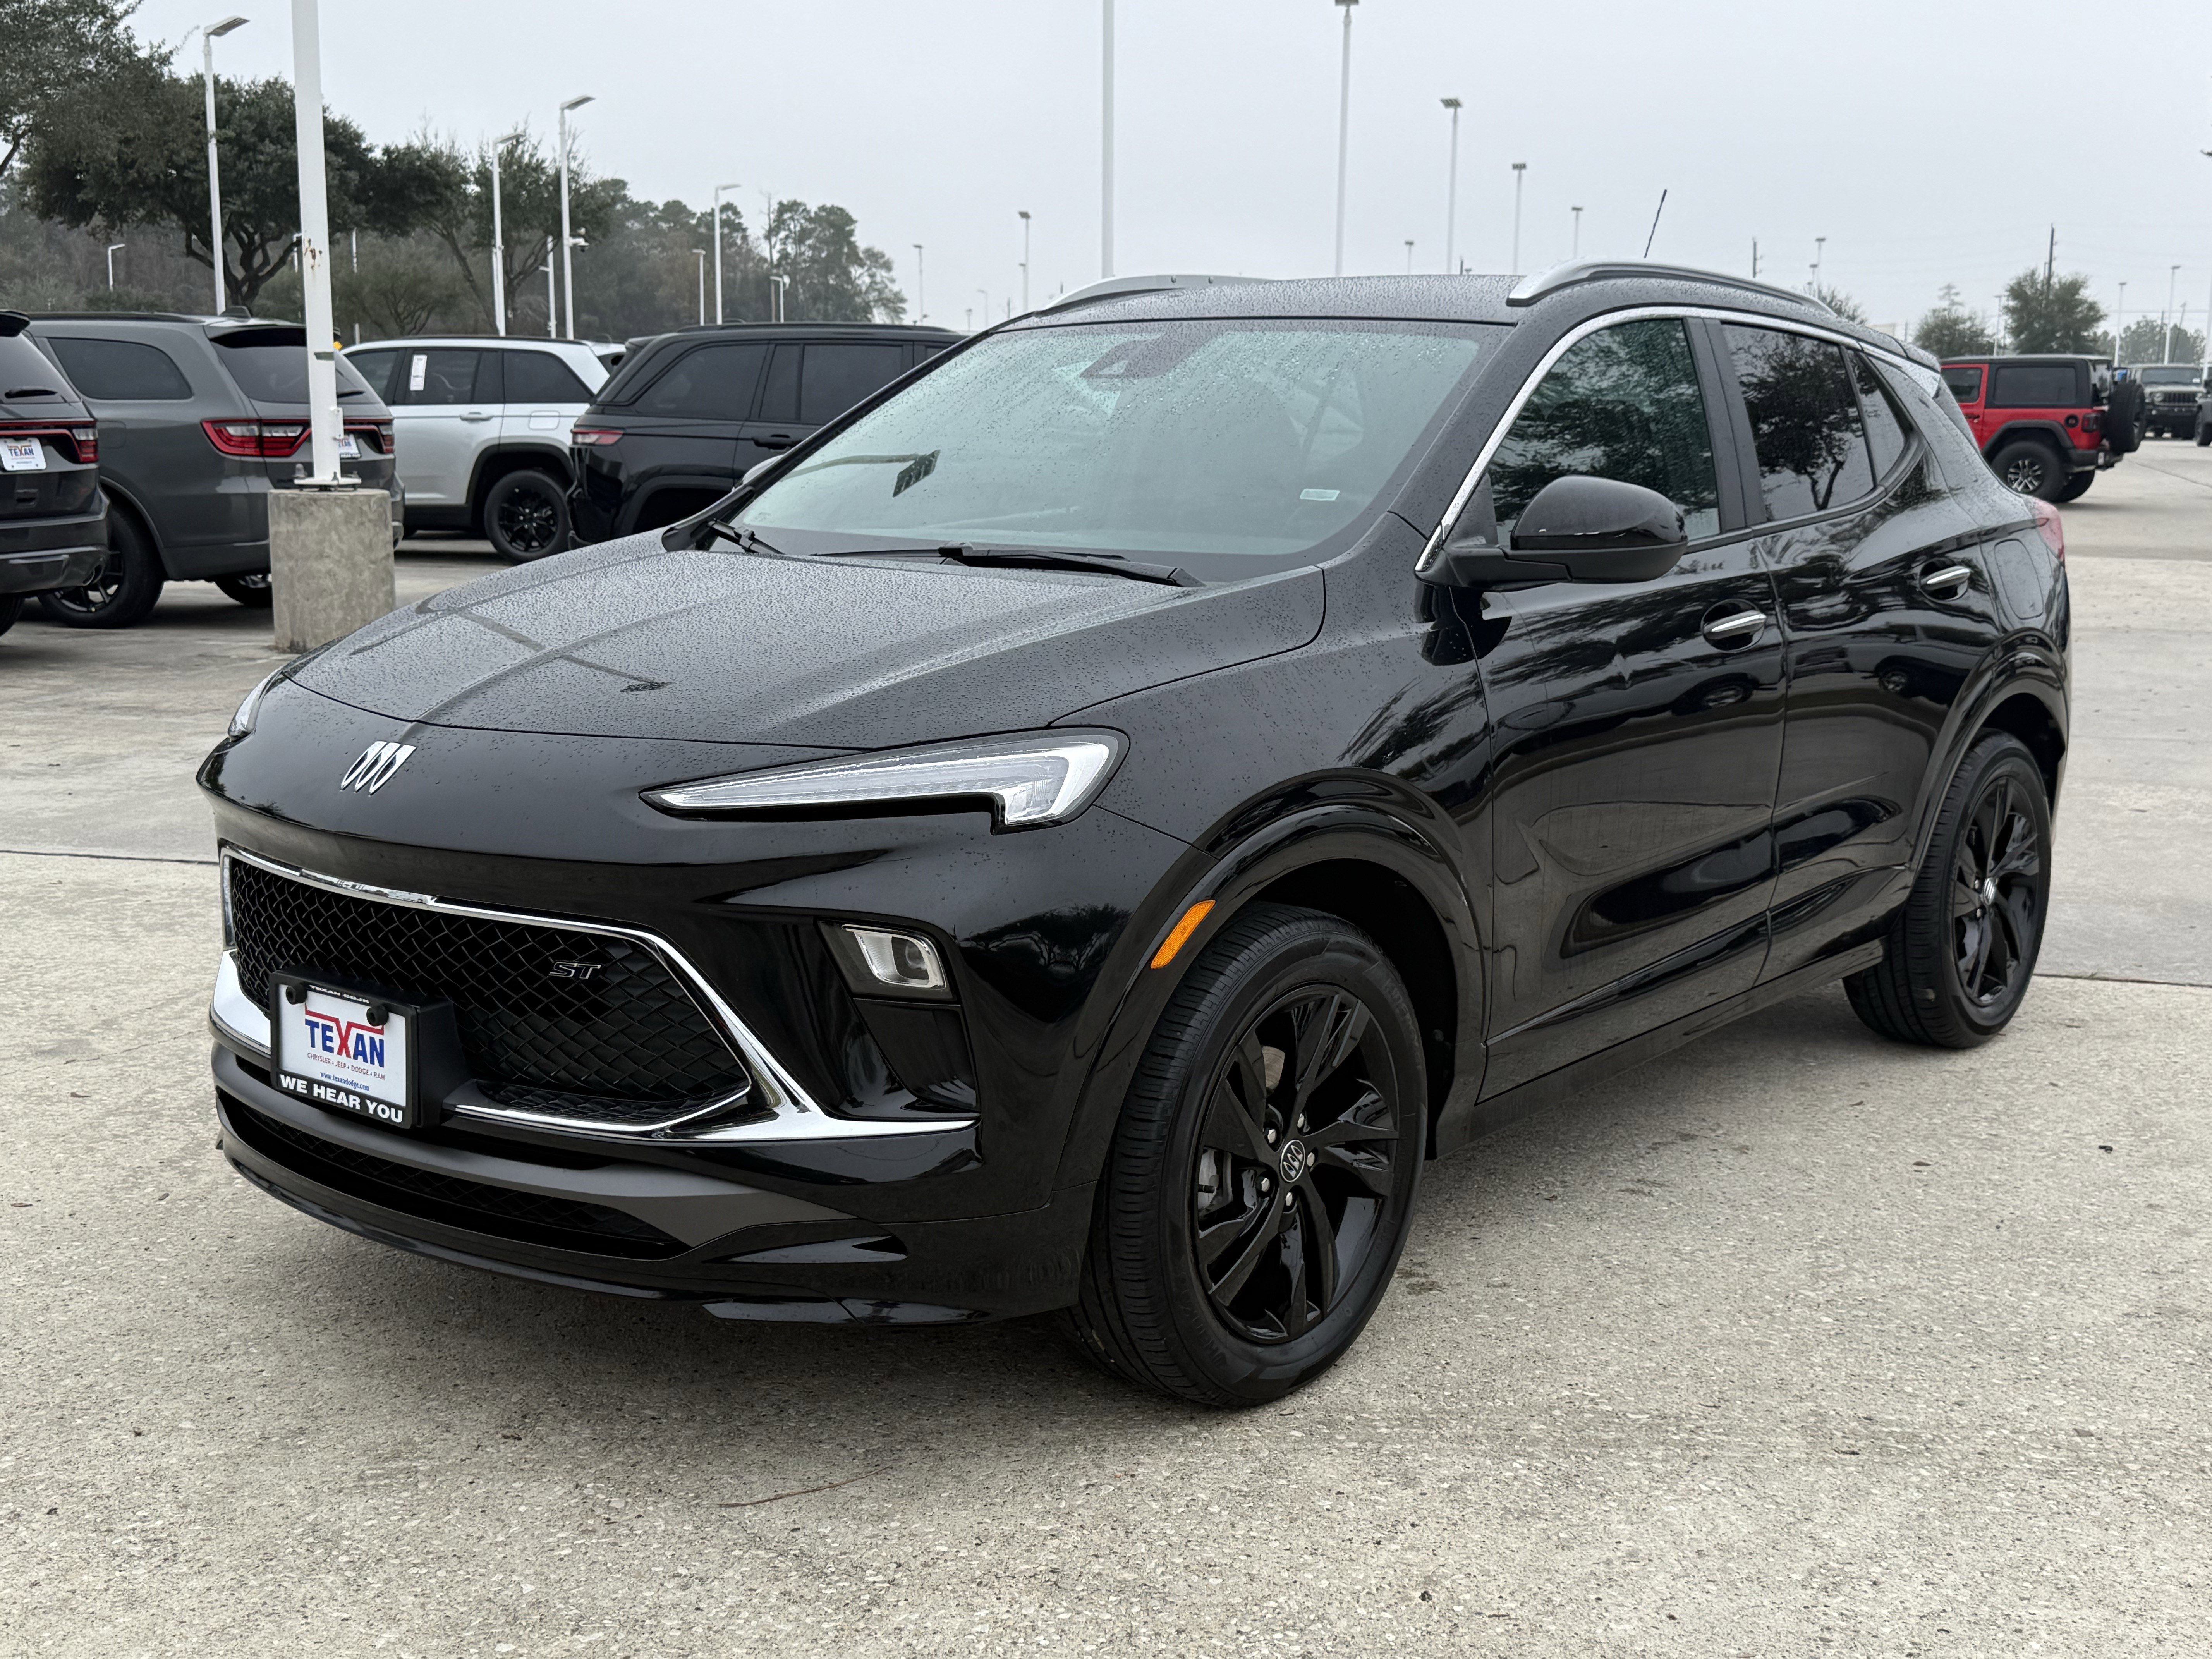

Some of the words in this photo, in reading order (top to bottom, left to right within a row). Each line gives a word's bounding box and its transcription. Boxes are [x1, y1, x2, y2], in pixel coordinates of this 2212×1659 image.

[8, 446, 34, 456] TEXAN
[549, 962, 602, 979] ST
[305, 1018, 384, 1068] TEXAN
[307, 1052, 331, 1064] CHRYSLER
[335, 1061, 347, 1069] JEEP
[351, 1065, 369, 1075] DODGE
[374, 1072, 386, 1080] RAM
[320, 1072, 369, 1091] www.texandodge.com
[280, 1074, 307, 1094] WE
[313, 1083, 360, 1110] HEAR
[365, 1099, 403, 1123] YOU
